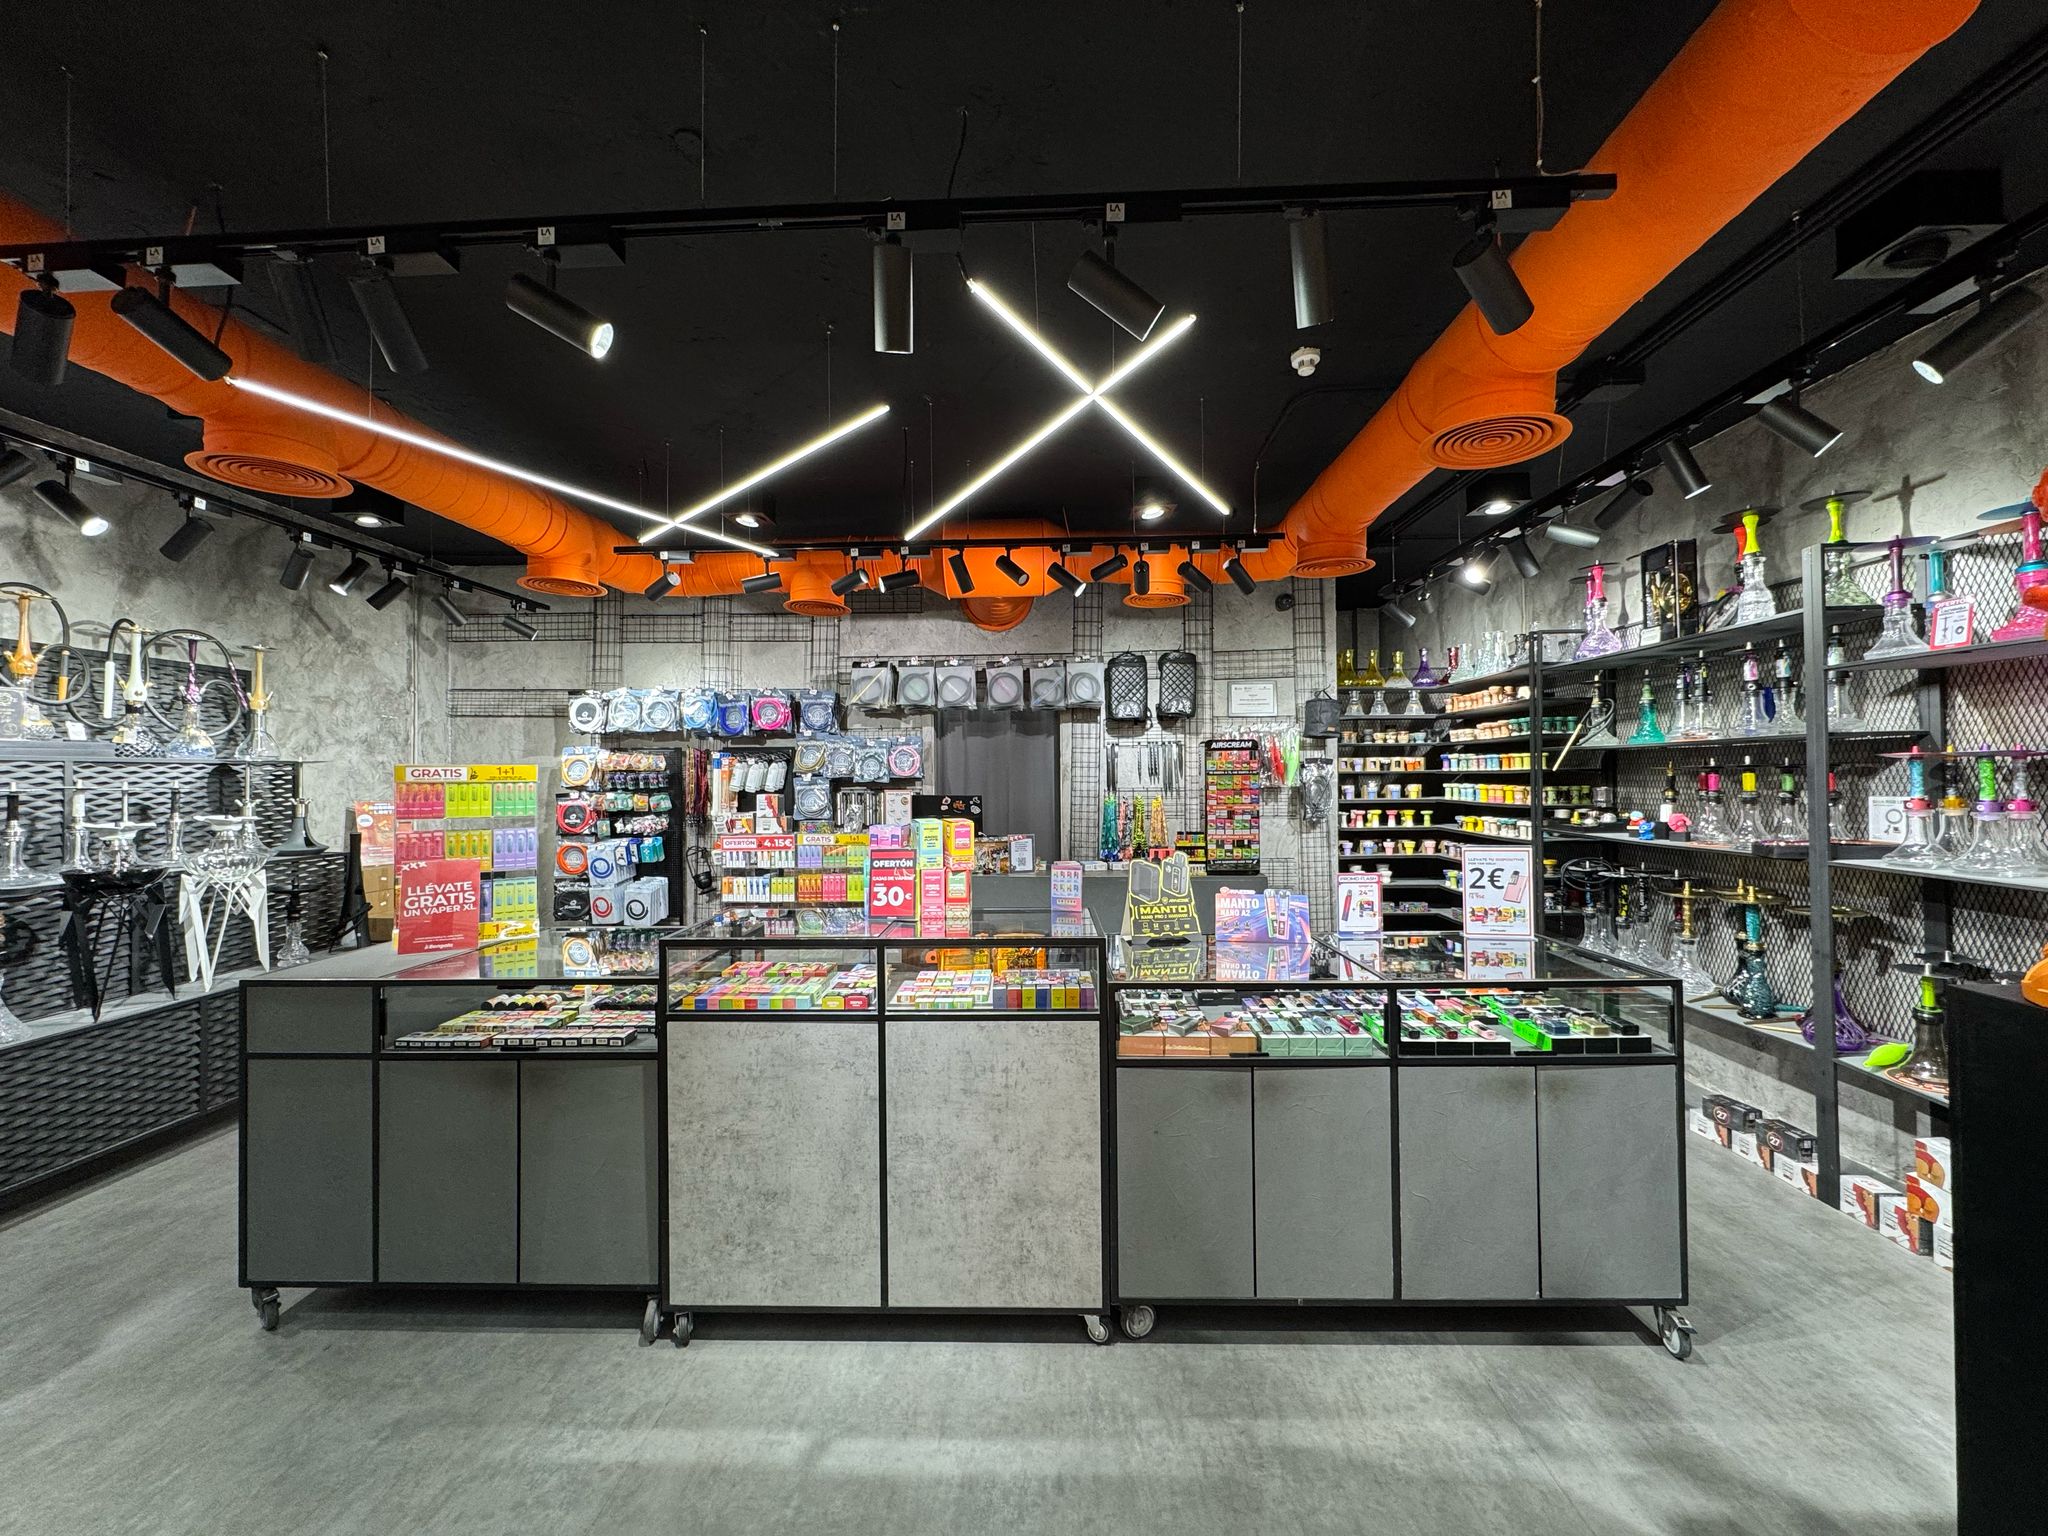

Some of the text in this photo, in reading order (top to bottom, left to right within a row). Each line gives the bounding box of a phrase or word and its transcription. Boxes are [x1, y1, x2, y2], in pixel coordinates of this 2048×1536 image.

[1211, 741, 1252, 749] AIRSCREAM
[410, 766, 515, 778] GRATIS 1+1
[763, 839, 793, 848] 4.15€
[872, 858, 913, 868] OFERTÓN
[1469, 867, 1505, 890] 2€
[407, 881, 473, 897] LLÉVATE
[404, 891, 476, 910] GRATIS
[1220, 898, 1260, 909] MANTO
[403, 909, 420, 918] UN
[422, 905, 461, 916] VAPER
[1140, 905, 1188, 915] MANTO
[1221, 909, 1240, 917] NANO
